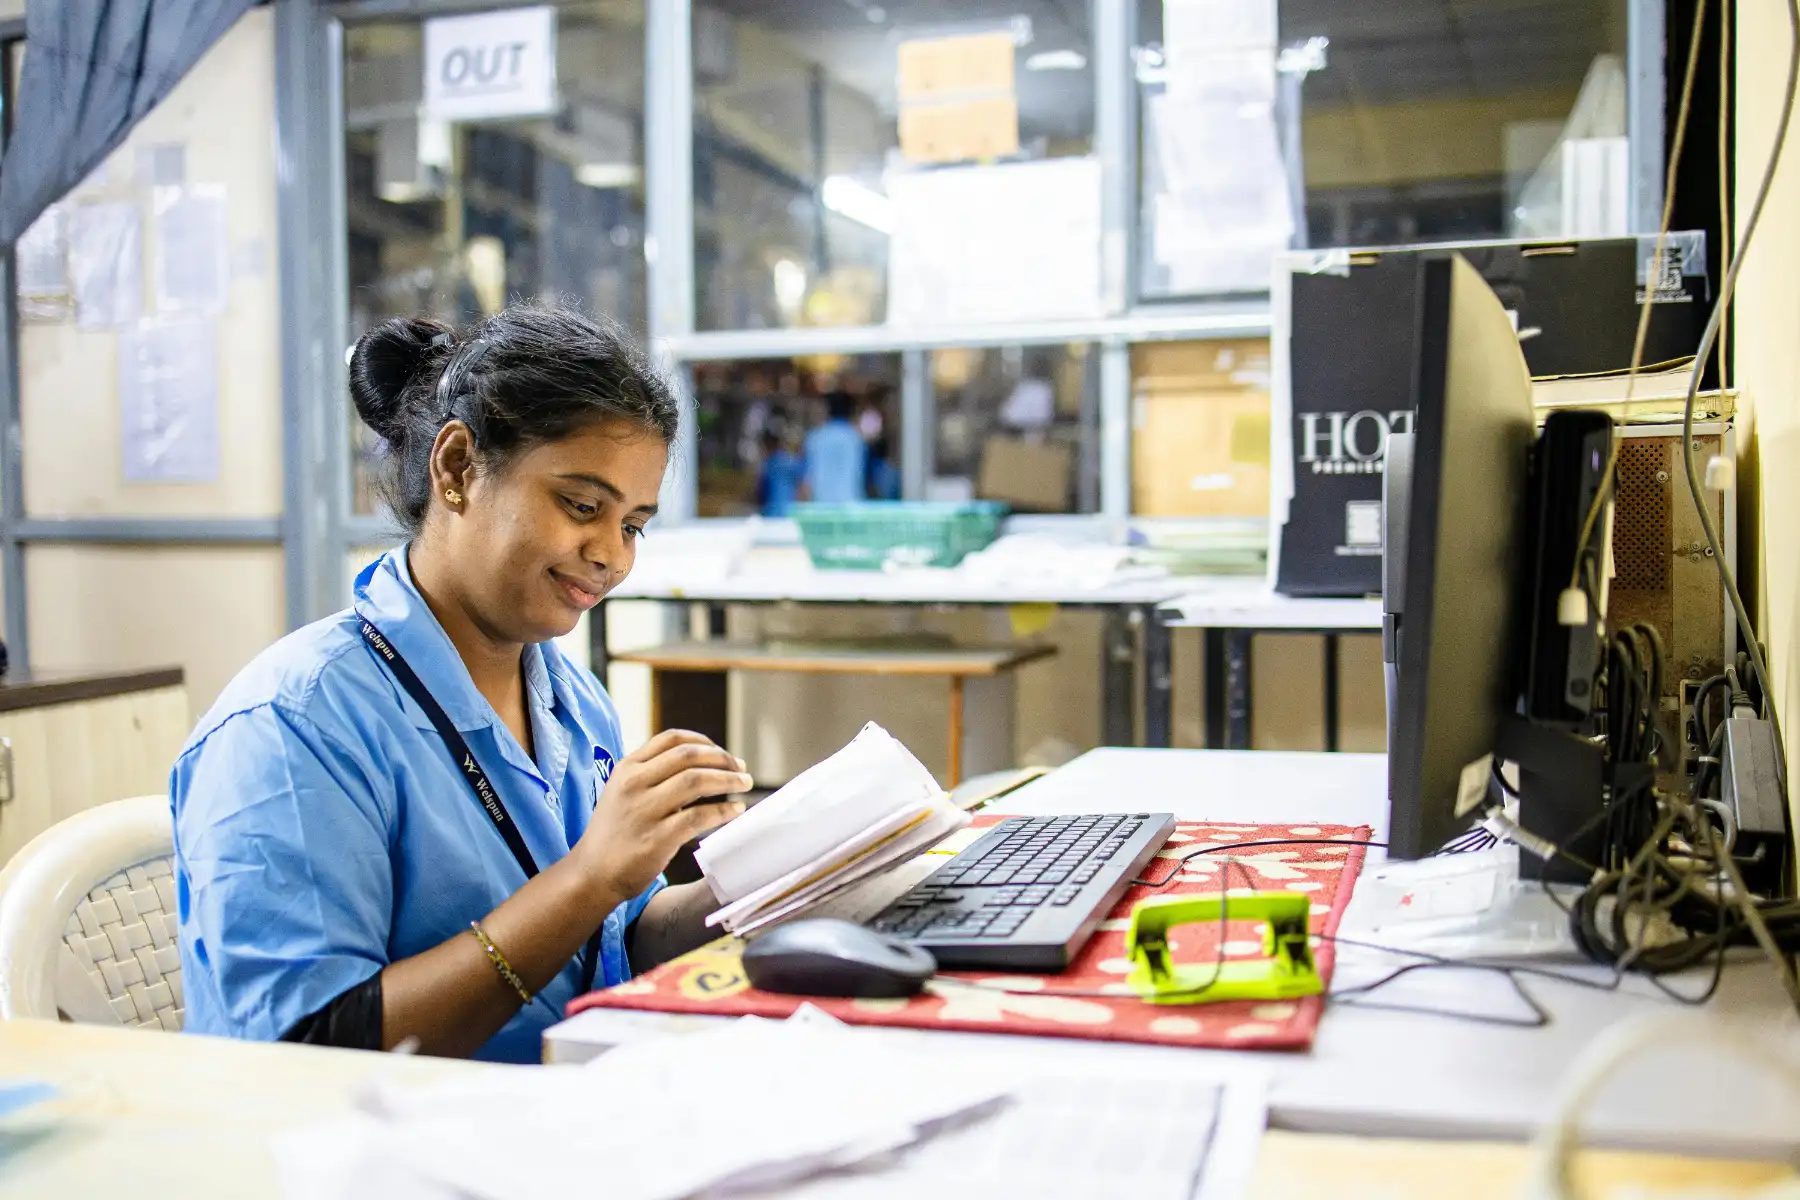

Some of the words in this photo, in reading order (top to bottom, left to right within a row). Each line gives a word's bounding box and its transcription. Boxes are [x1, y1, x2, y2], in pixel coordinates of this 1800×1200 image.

[441, 41, 530, 85] OUT
[362, 623, 395, 660] Welspun
[476, 778, 504, 822] Welspun
